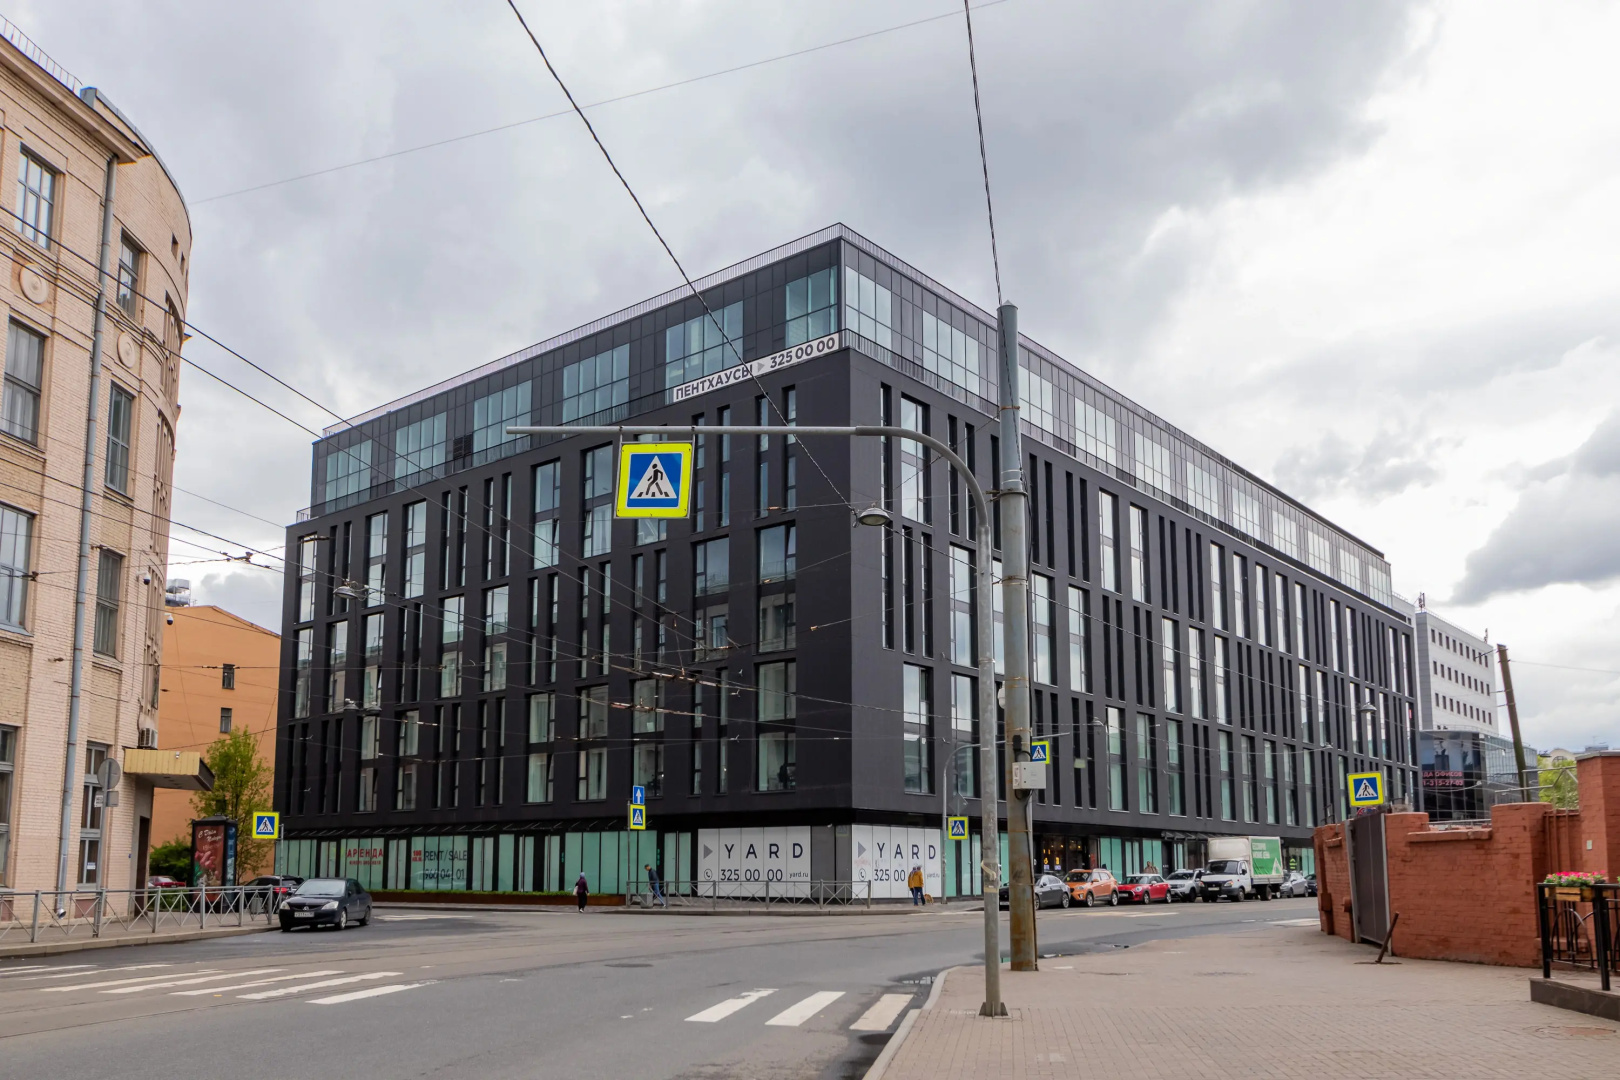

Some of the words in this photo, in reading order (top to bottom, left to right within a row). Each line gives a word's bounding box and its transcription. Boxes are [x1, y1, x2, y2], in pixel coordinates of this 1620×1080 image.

[675, 364, 753, 400] ПЕНТХАУСЫ
[769, 352, 793, 369] 325
[795, 343, 813, 360] 00
[816, 336, 835, 353] 00
[346, 848, 384, 859] АРЕНДА
[724, 843, 804, 860] YARD
[876, 842, 936, 860] YARD
[720, 868, 740, 881] 325
[744, 868, 761, 881] 00
[766, 868, 783, 881] 00
[788, 871, 809, 879] yard.ru
[873, 868, 890, 881] 325
[893, 869, 906, 882] 00
